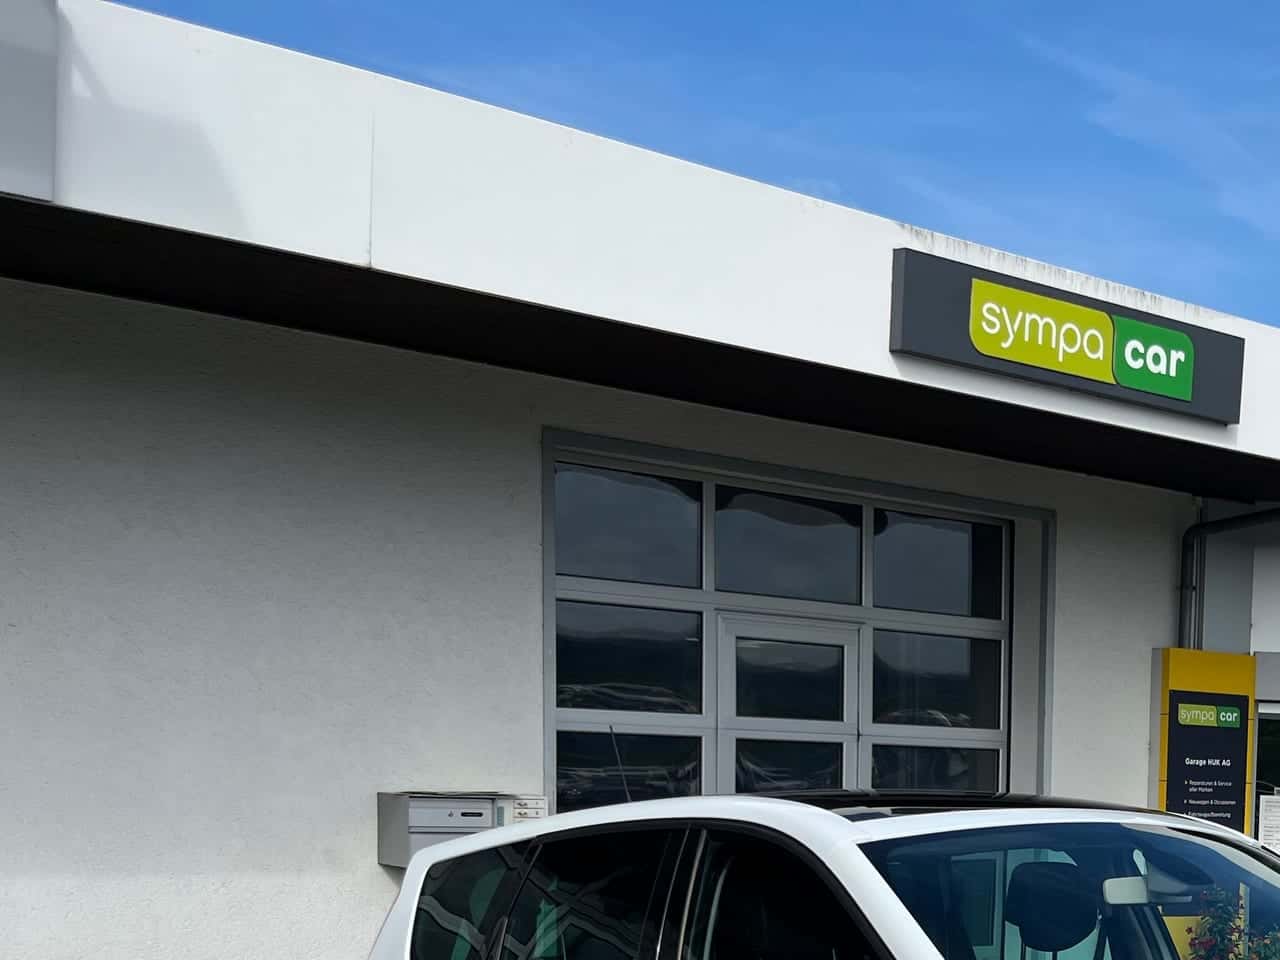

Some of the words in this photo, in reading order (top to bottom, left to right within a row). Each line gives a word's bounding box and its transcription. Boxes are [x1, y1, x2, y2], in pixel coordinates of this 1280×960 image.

[981, 302, 1104, 362] sympa
[1124, 339, 1185, 377] car
[1181, 709, 1215, 723] sympa
[1219, 711, 1238, 722] car
[1185, 757, 1207, 767] Garage
[1207, 758, 1221, 767] HUK
[1221, 759, 1231, 767] AG
